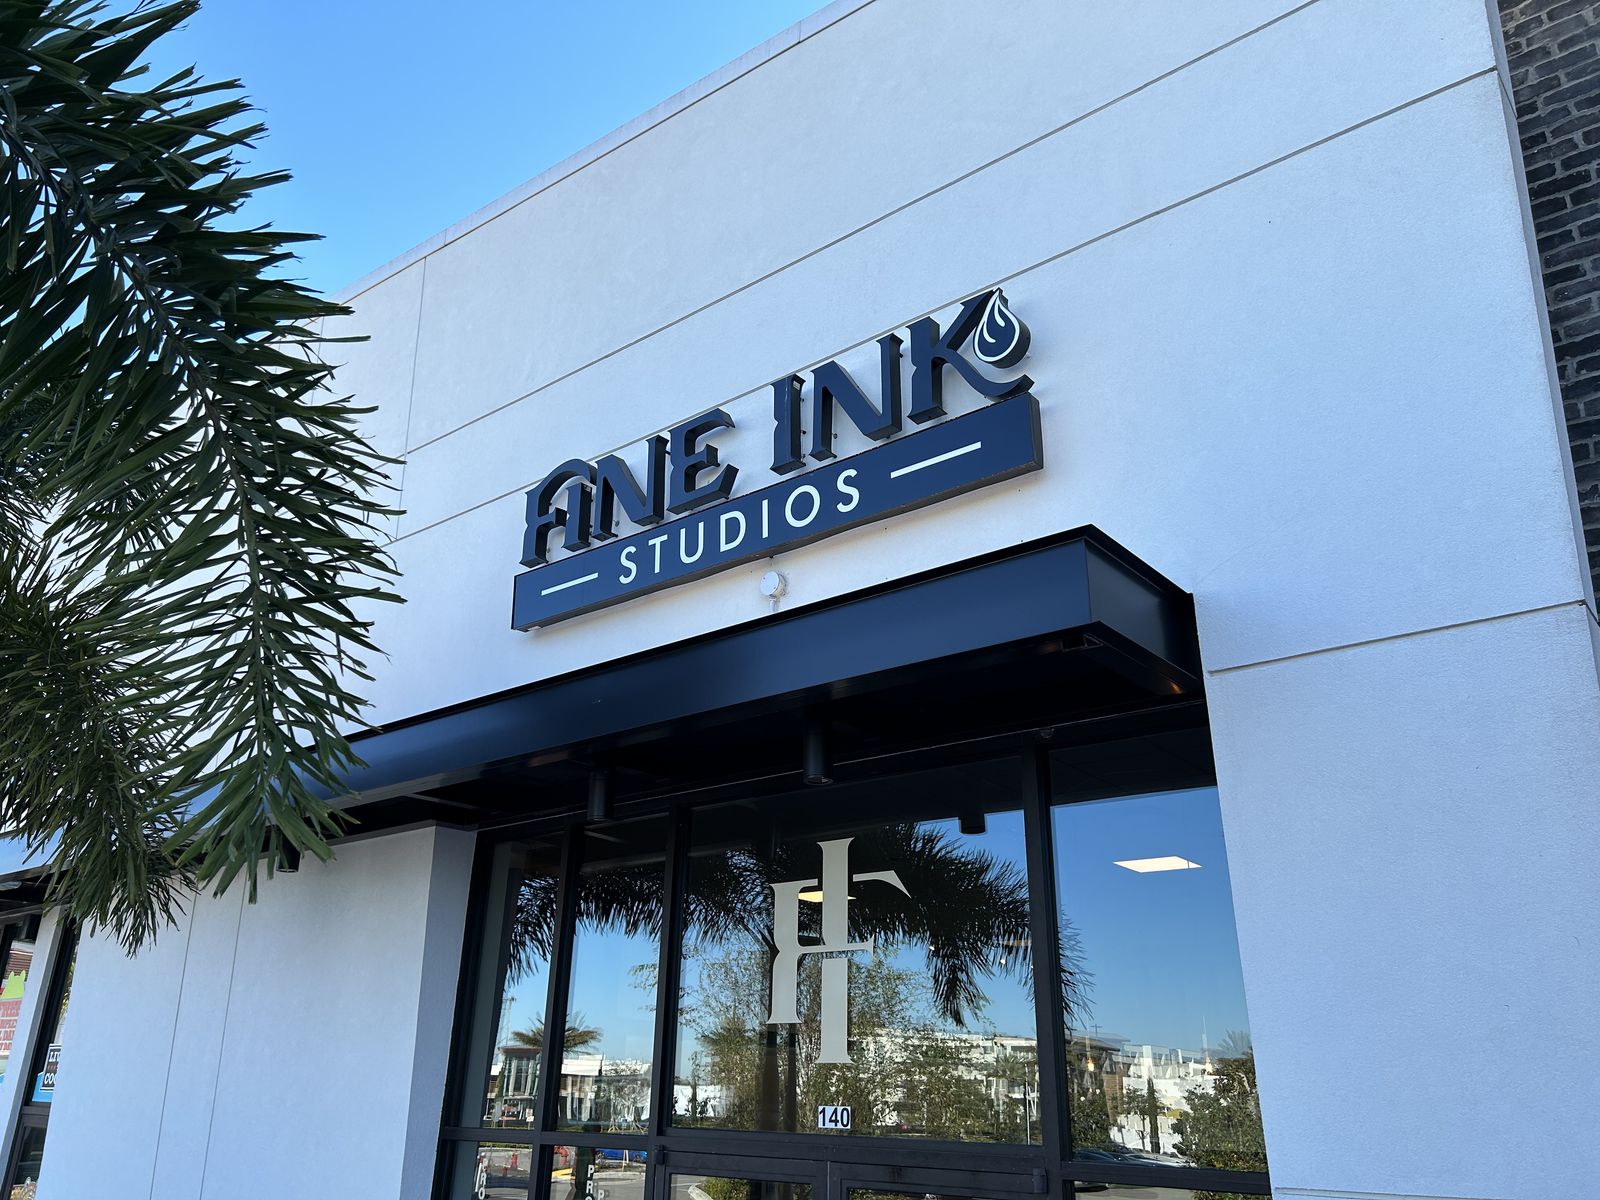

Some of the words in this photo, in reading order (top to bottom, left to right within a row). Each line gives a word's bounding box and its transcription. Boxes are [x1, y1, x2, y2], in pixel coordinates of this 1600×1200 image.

[769, 288, 1034, 475] INK
[618, 468, 860, 584] STUDIOS
[819, 1107, 850, 1127] 140
